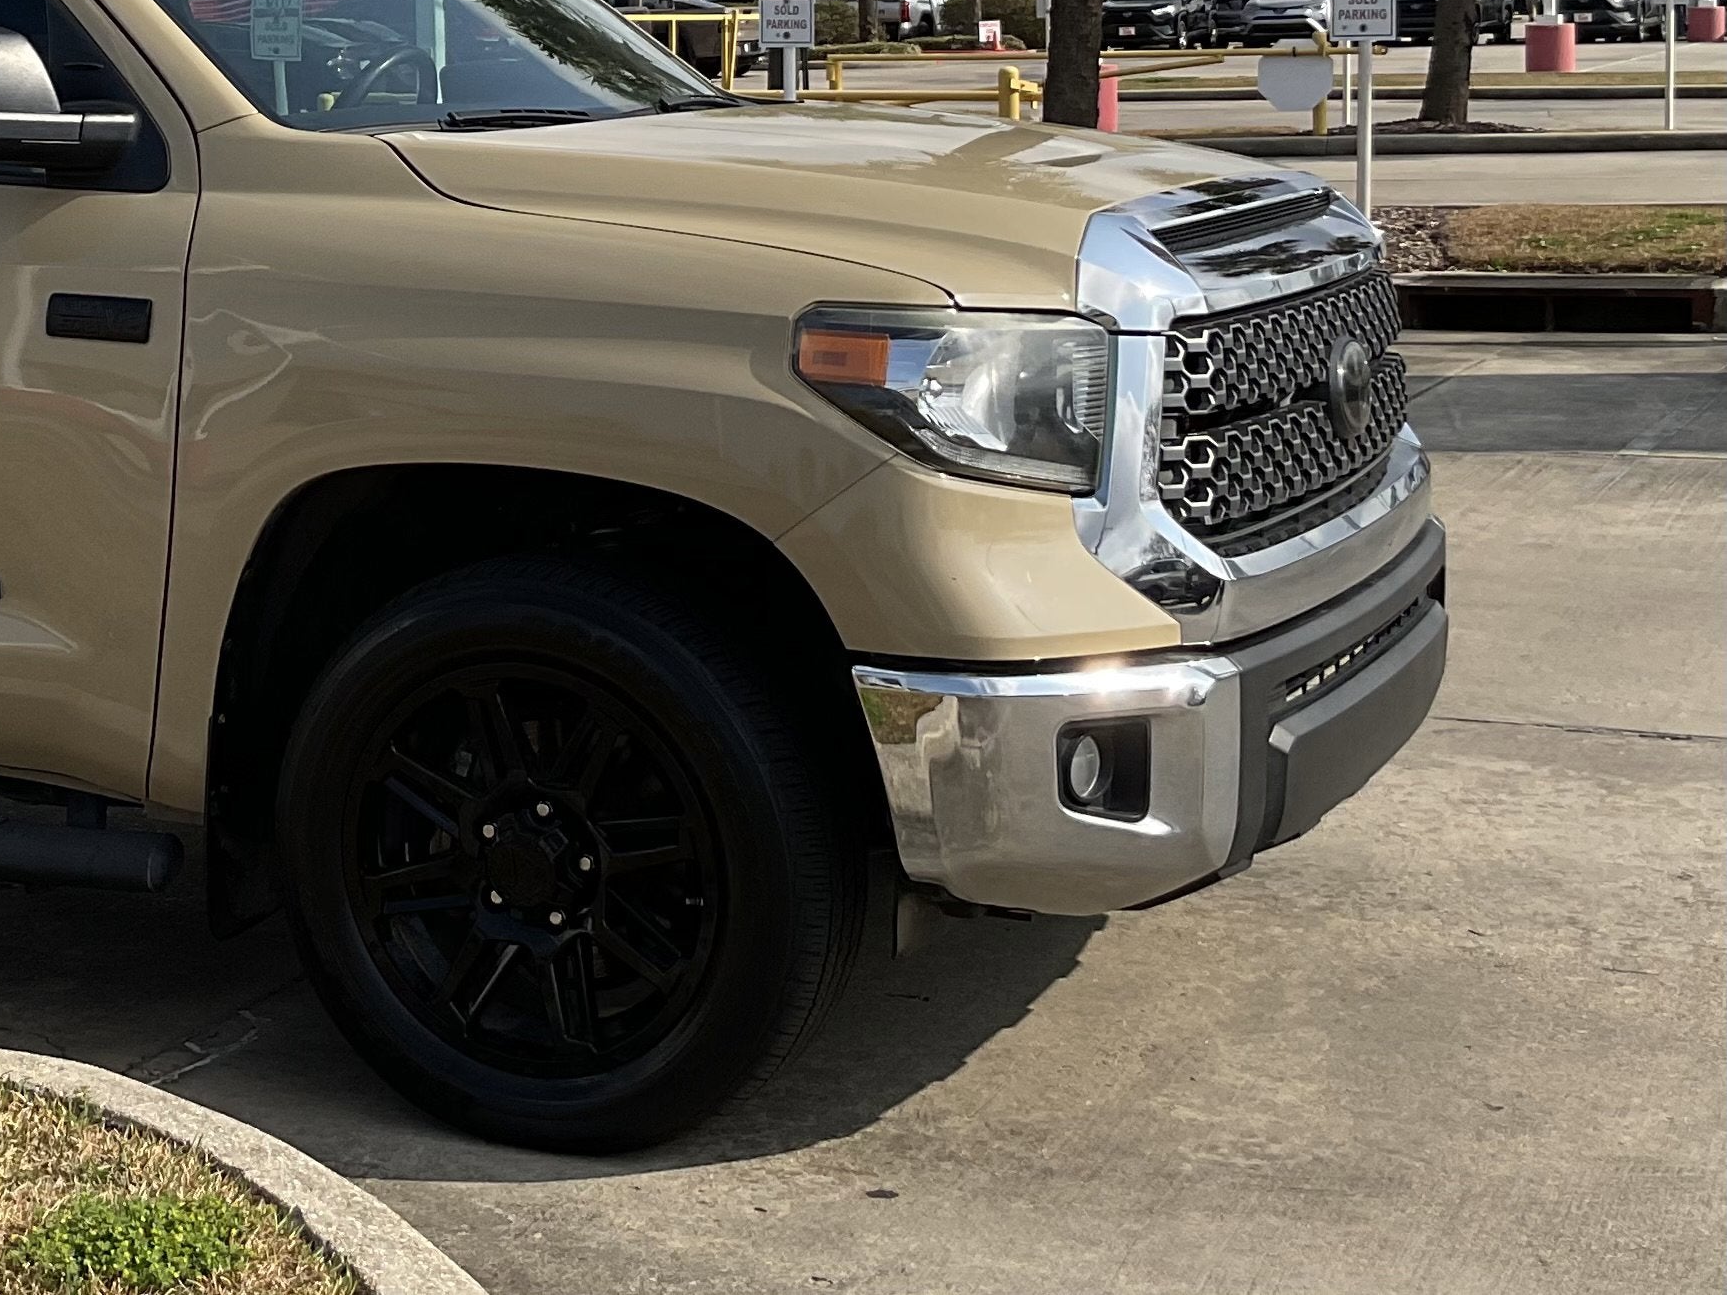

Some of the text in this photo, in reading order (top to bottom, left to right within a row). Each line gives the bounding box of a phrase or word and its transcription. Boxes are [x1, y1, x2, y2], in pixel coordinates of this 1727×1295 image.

[774, 5, 800, 16] SOLD
[1338, 8, 1388, 21] PARKING
[766, 18, 808, 30] PARKING
